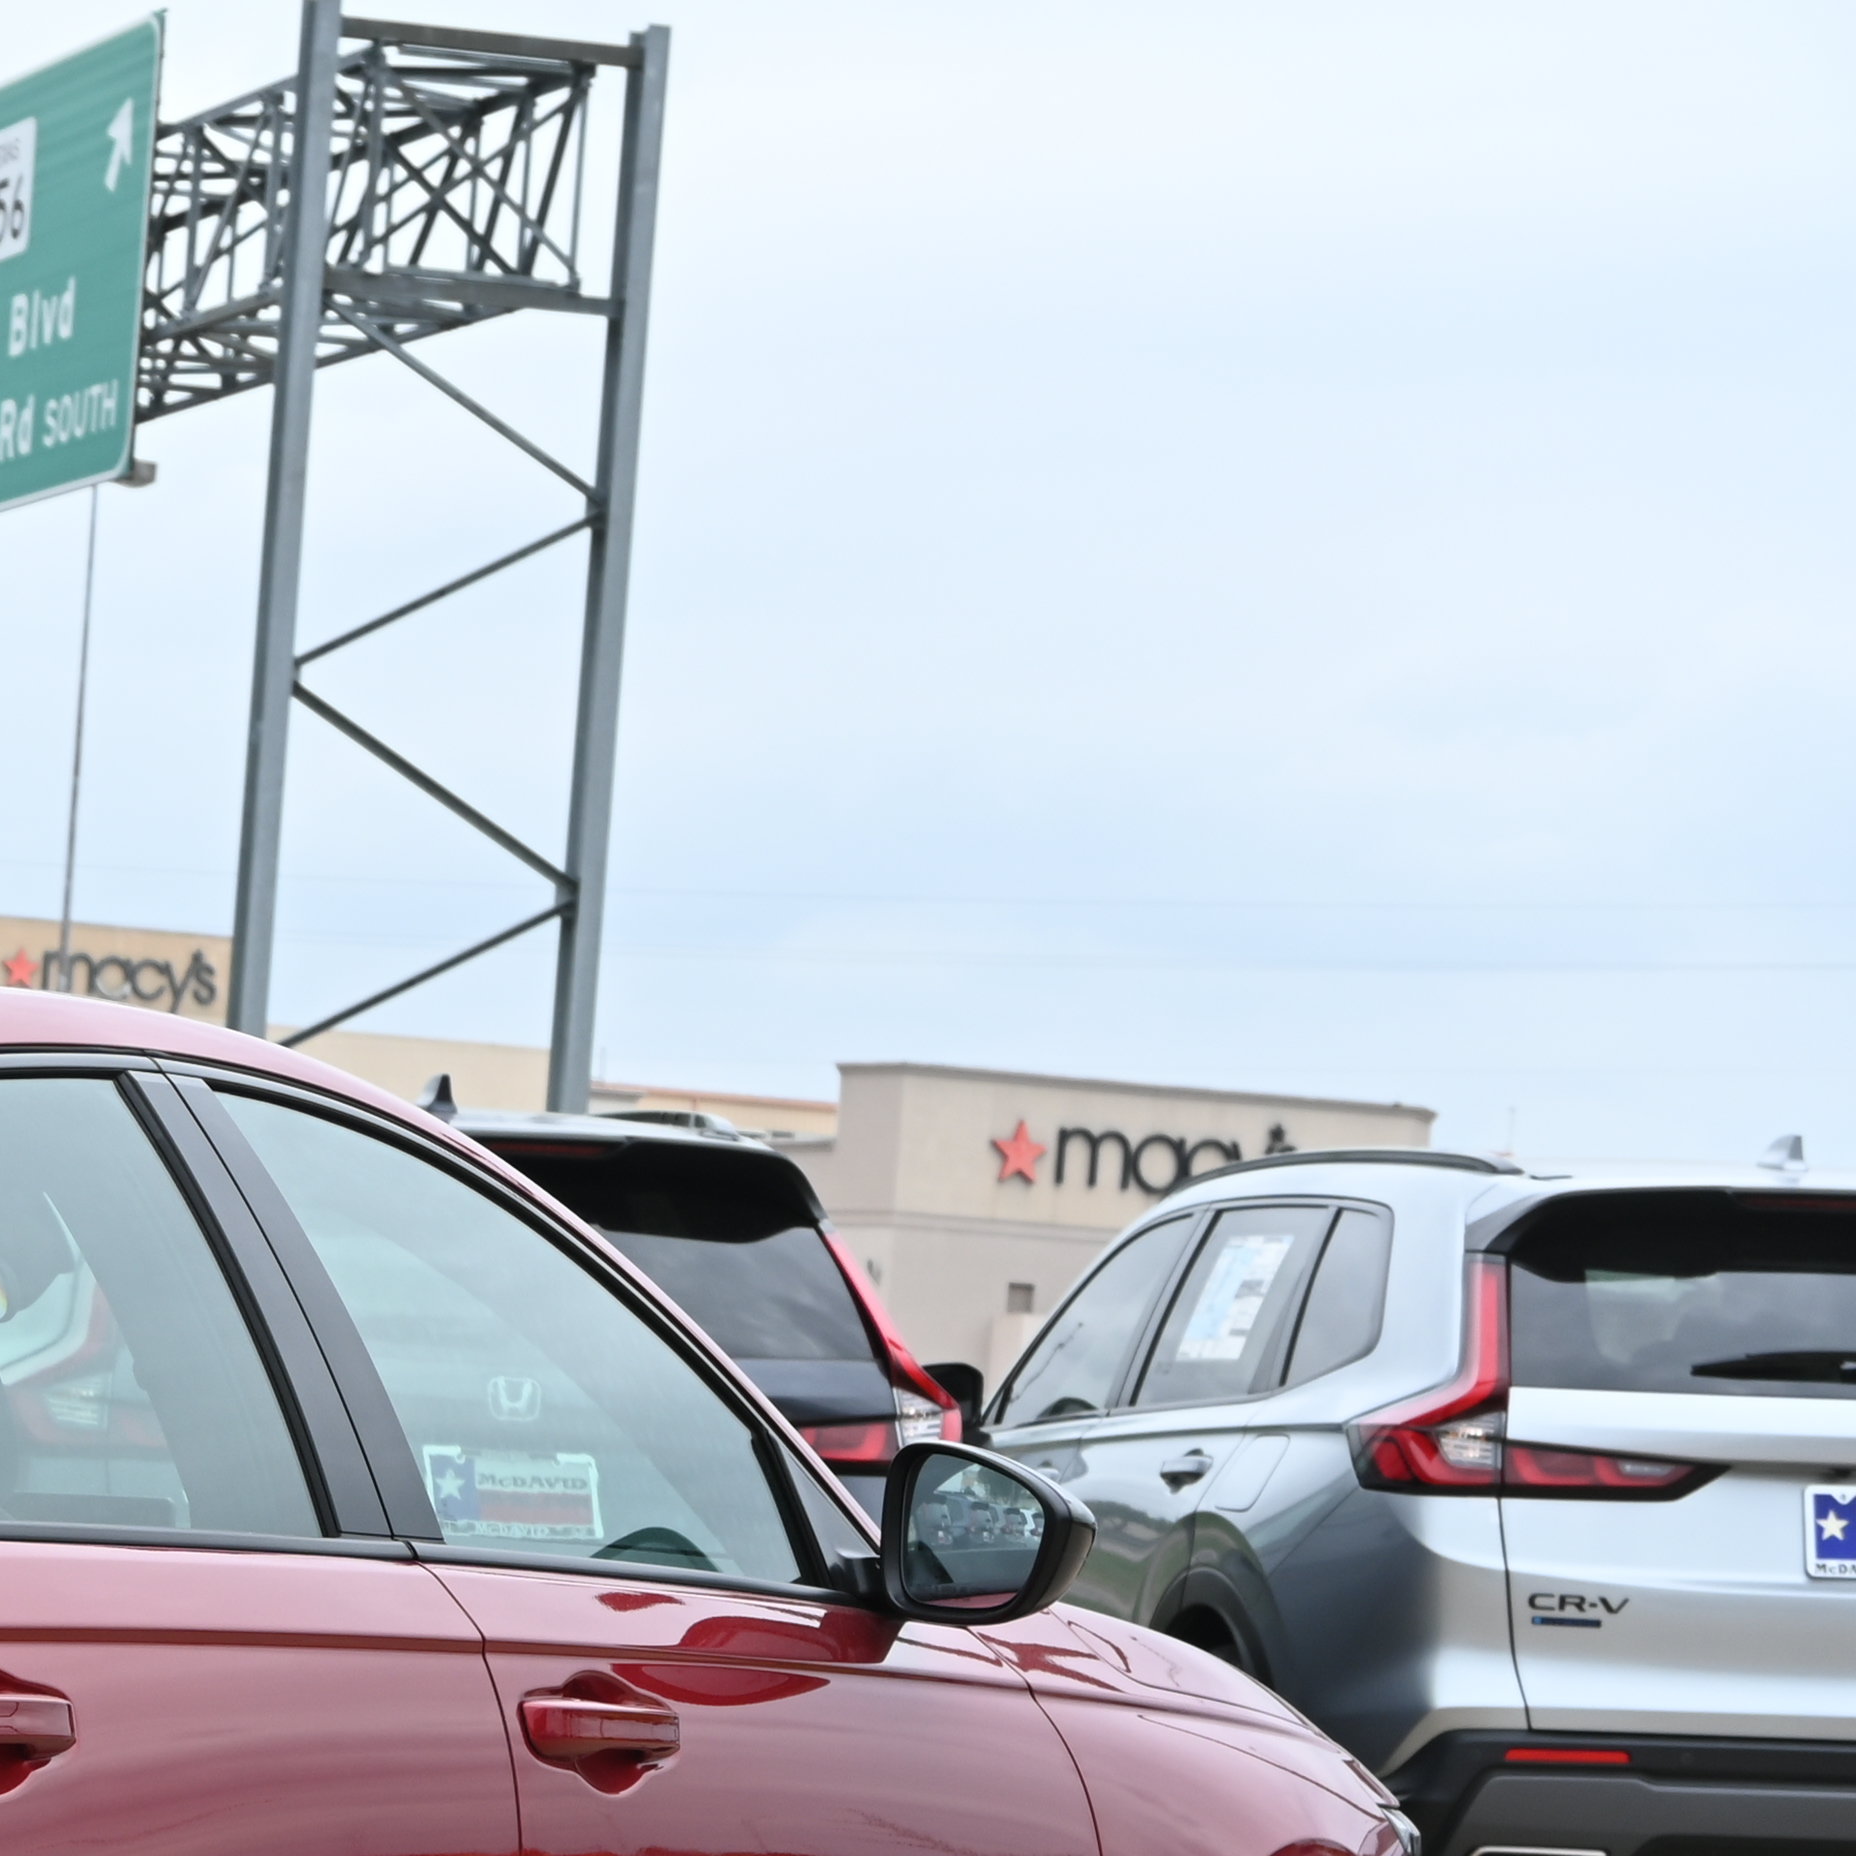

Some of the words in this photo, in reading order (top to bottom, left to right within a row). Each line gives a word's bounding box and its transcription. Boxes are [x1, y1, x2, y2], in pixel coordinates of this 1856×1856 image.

[8, 276, 77, 358] Blvd
[42, 379, 118, 449] SOUTH
[42, 948, 217, 1014] macy's
[478, 1473, 587, 1490] McDAVID
[1528, 1592, 1630, 1615] CR-V
